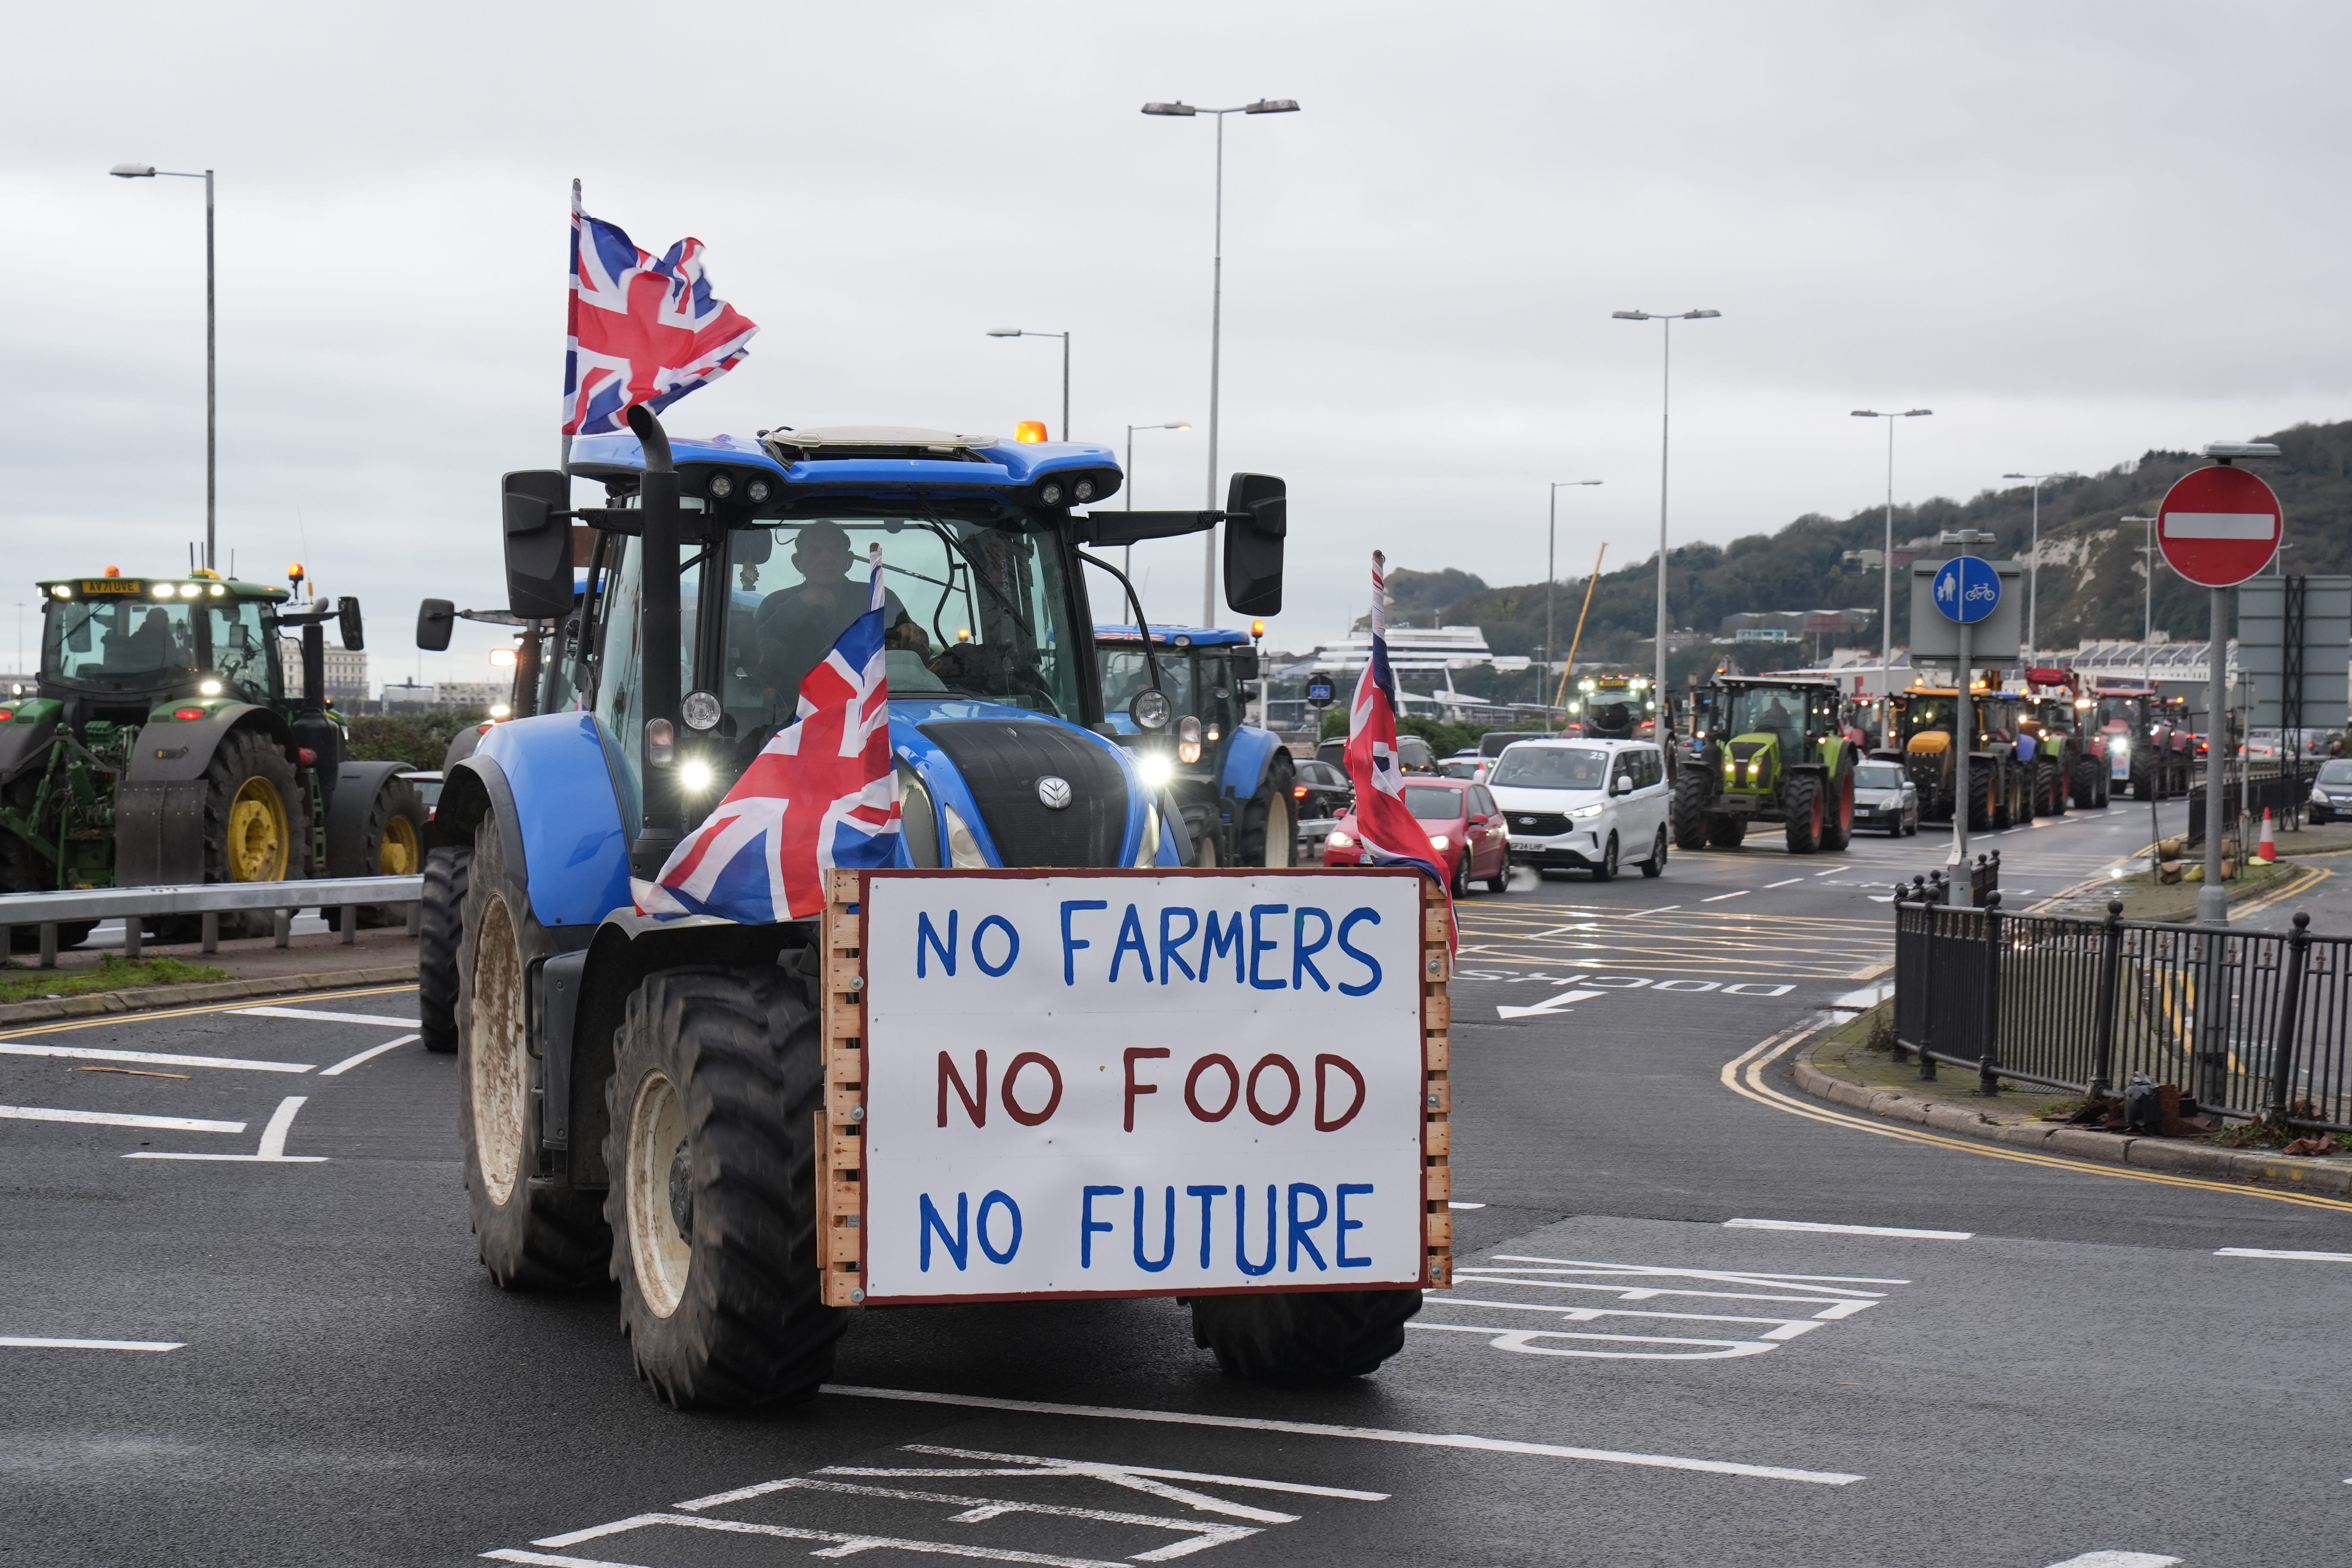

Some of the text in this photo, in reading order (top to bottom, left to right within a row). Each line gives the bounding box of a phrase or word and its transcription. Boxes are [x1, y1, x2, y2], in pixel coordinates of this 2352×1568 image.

[1589, 751, 1606, 760] 25
[917, 900, 1382, 997] NO FARMERS
[1451, 970, 1797, 997] DOCKS
[936, 1047, 1366, 1133] NO FOOD
[920, 1183, 1374, 1276] NO FUTURE
